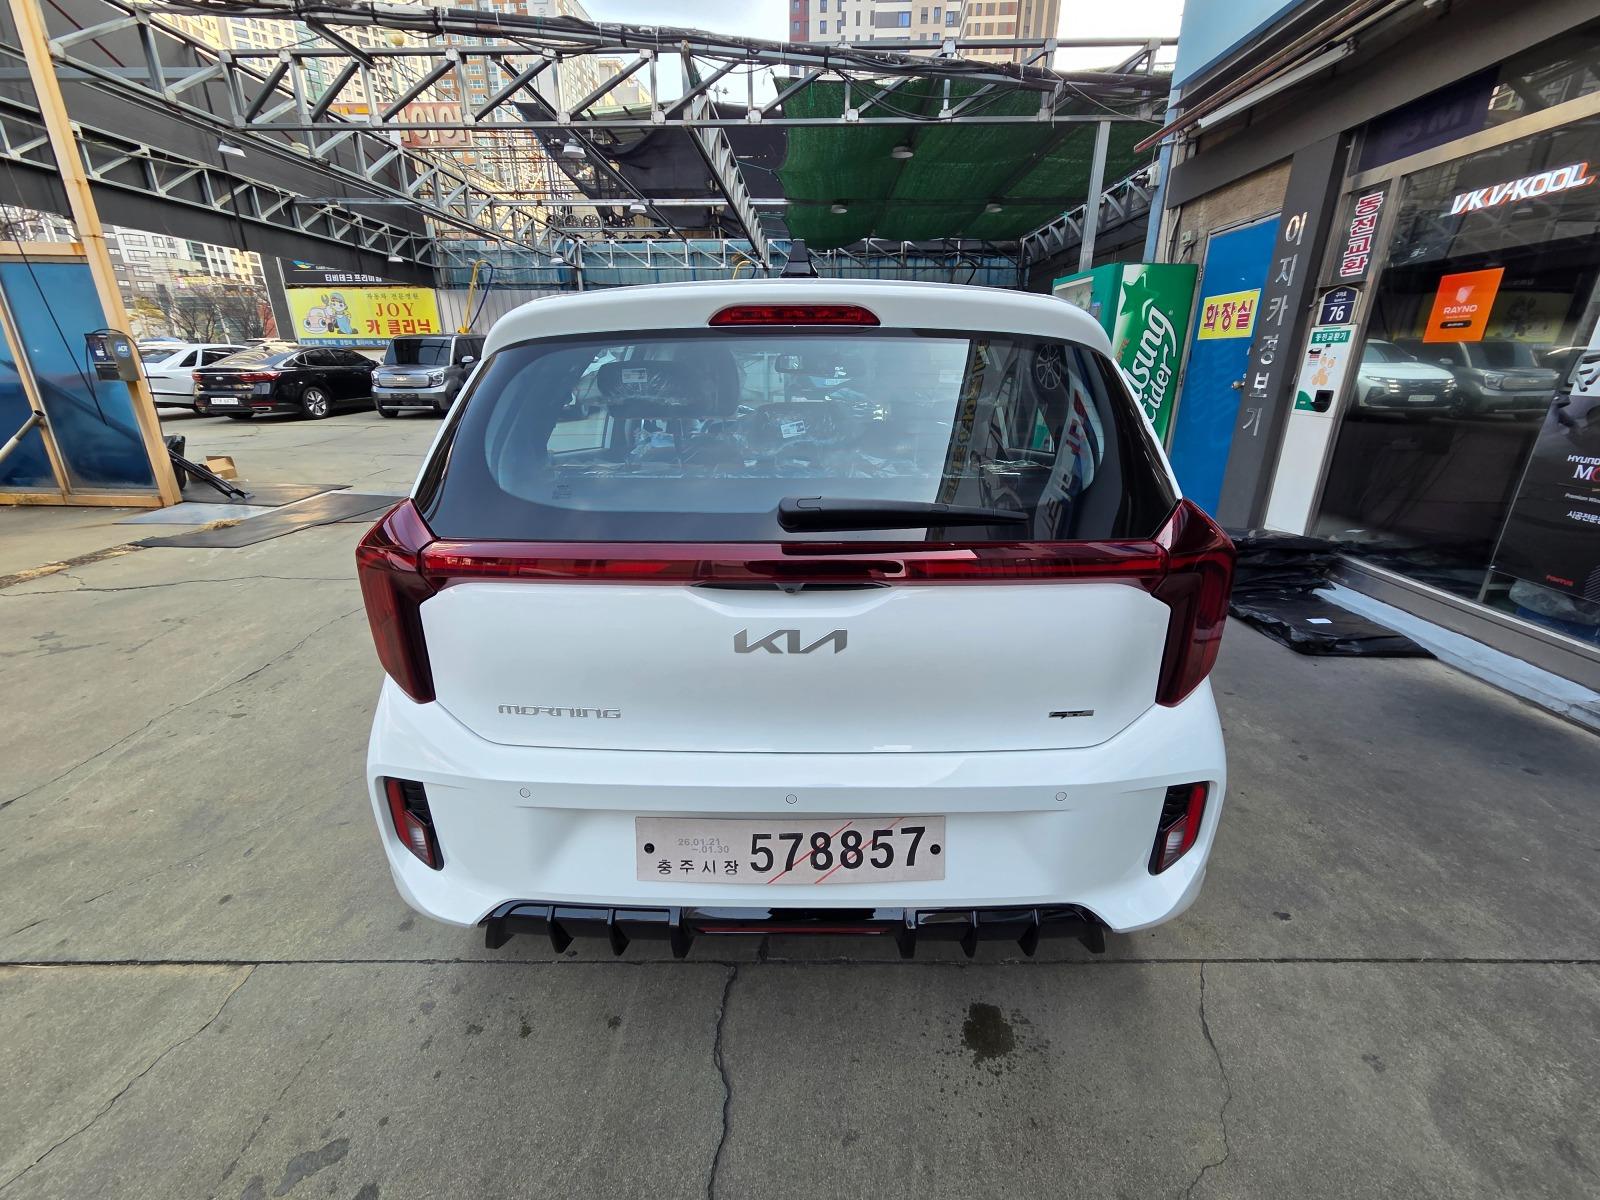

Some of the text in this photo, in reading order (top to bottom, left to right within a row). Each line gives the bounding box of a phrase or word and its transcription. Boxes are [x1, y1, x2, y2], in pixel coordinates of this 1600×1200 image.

[1340, 191, 1384, 277] 동전교환
[375, 302, 415, 317] JOY
[1203, 300, 1254, 332] 화장실
[1328, 305, 1345, 322] 76
[1443, 304, 1478, 315] RAYNO
[366, 319, 432, 335] 카 클리닉
[733, 628, 848, 655] KIA
[498, 703, 622, 719] MORNING
[749, 826, 926, 872] 578857
[656, 859, 739, 876] 충주시장
